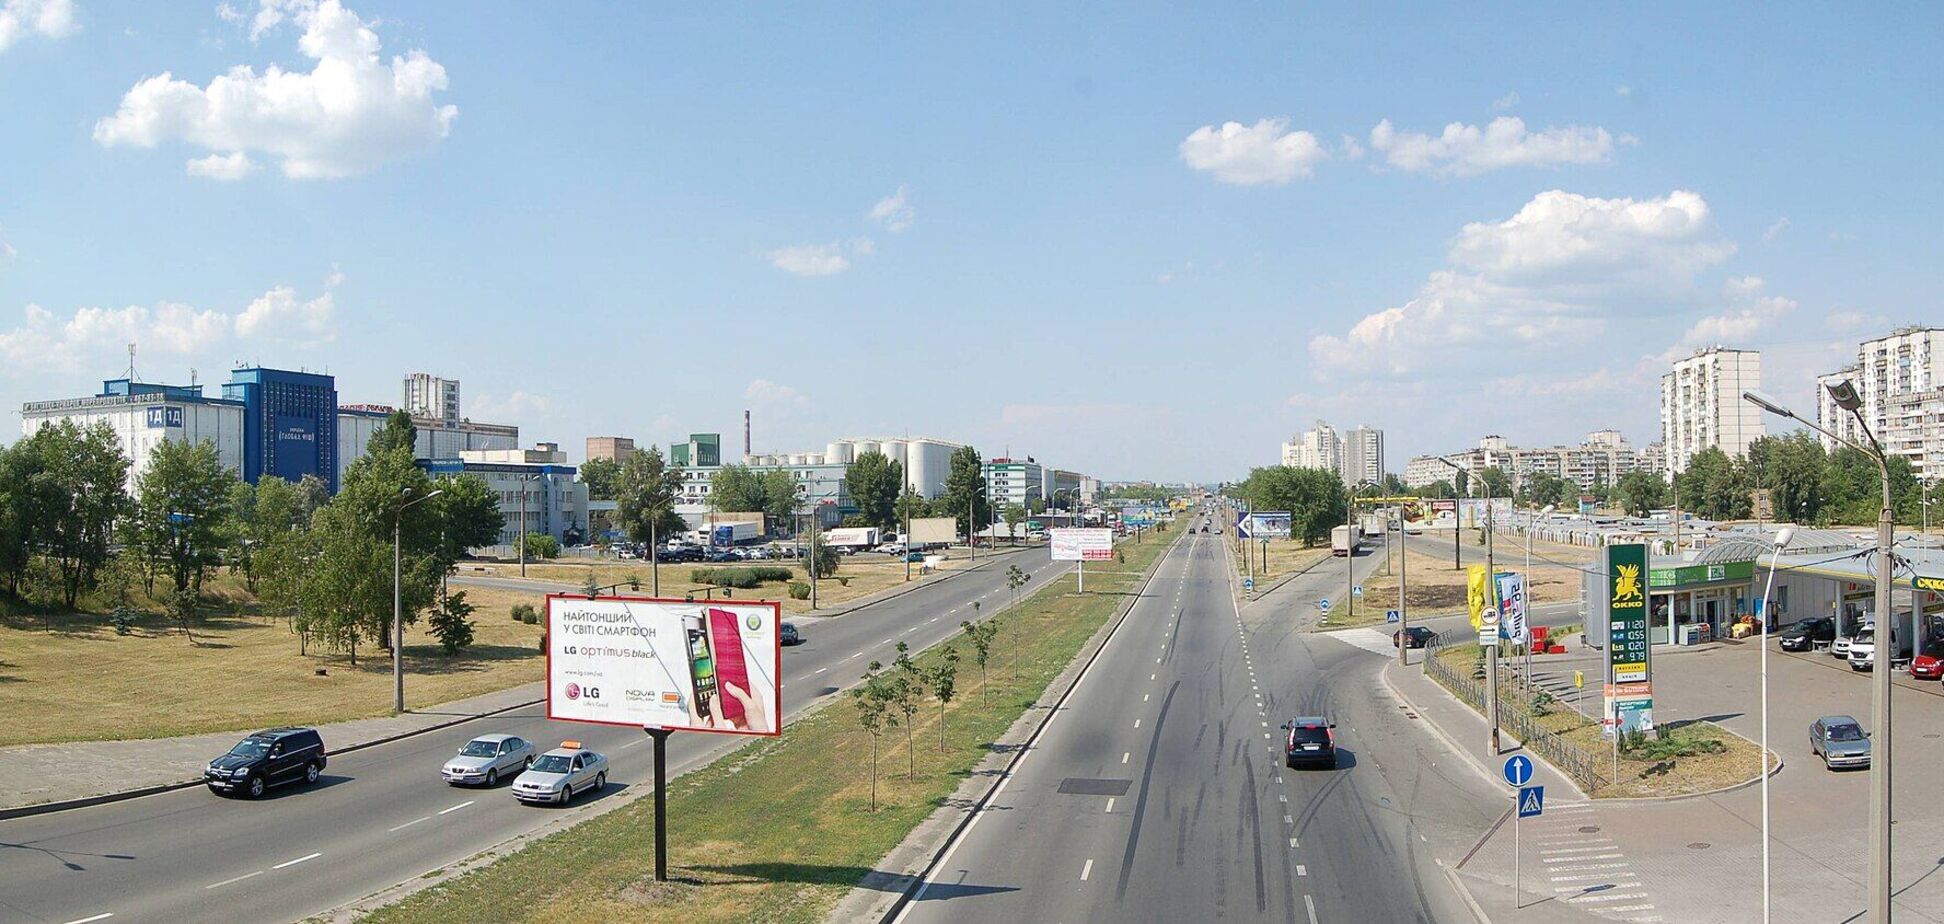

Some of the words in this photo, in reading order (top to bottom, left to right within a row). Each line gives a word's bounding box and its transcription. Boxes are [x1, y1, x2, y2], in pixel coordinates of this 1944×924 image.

[148, 411, 163, 424] 1Д
[167, 410, 181, 424] 1Д
[1612, 601, 1643, 609] OKKO
[563, 609, 632, 623] НАЙТОНШИЙ
[563, 624, 570, 633] У
[572, 624, 594, 635] СВІТІ
[596, 625, 656, 638] СМАРТФОН
[564, 646, 577, 655] LG
[632, 649, 657, 659] black
[583, 687, 600, 699] LG
[625, 689, 656, 697] NOVA
